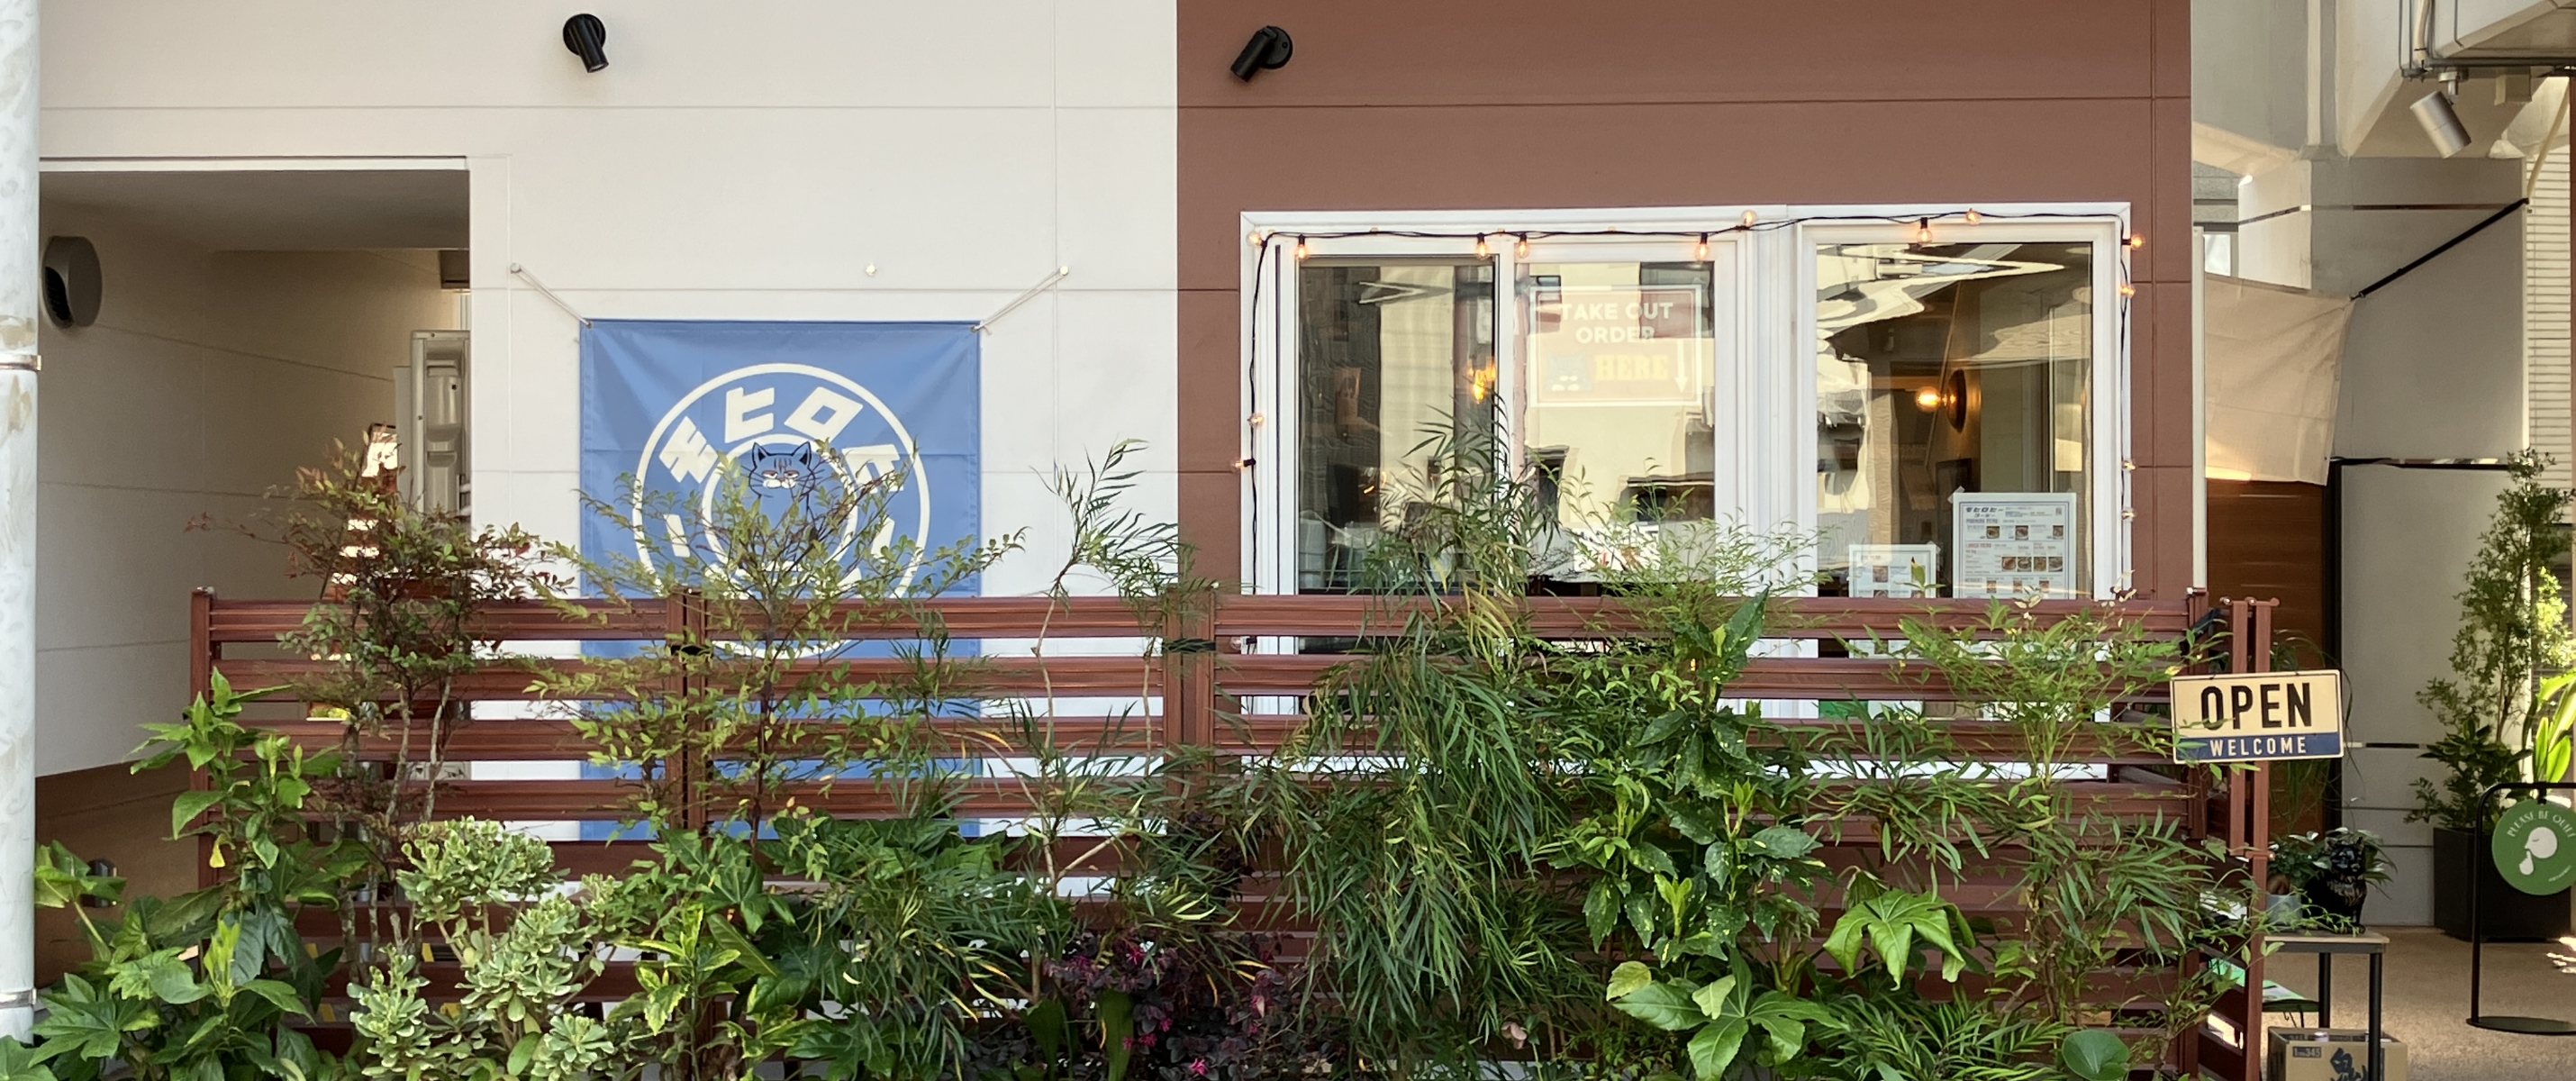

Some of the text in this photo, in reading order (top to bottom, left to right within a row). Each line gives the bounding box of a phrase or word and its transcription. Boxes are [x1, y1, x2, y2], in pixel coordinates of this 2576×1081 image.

[1561, 302, 1673, 321] TAKE OUT
[1575, 325, 1656, 344] ORDER
[1594, 352, 1669, 382] HERE
[2200, 682, 2312, 731] OPEN
[2209, 736, 2308, 758] WELCOME
[2507, 811, 2576, 838] PLEASE BE QUIET
